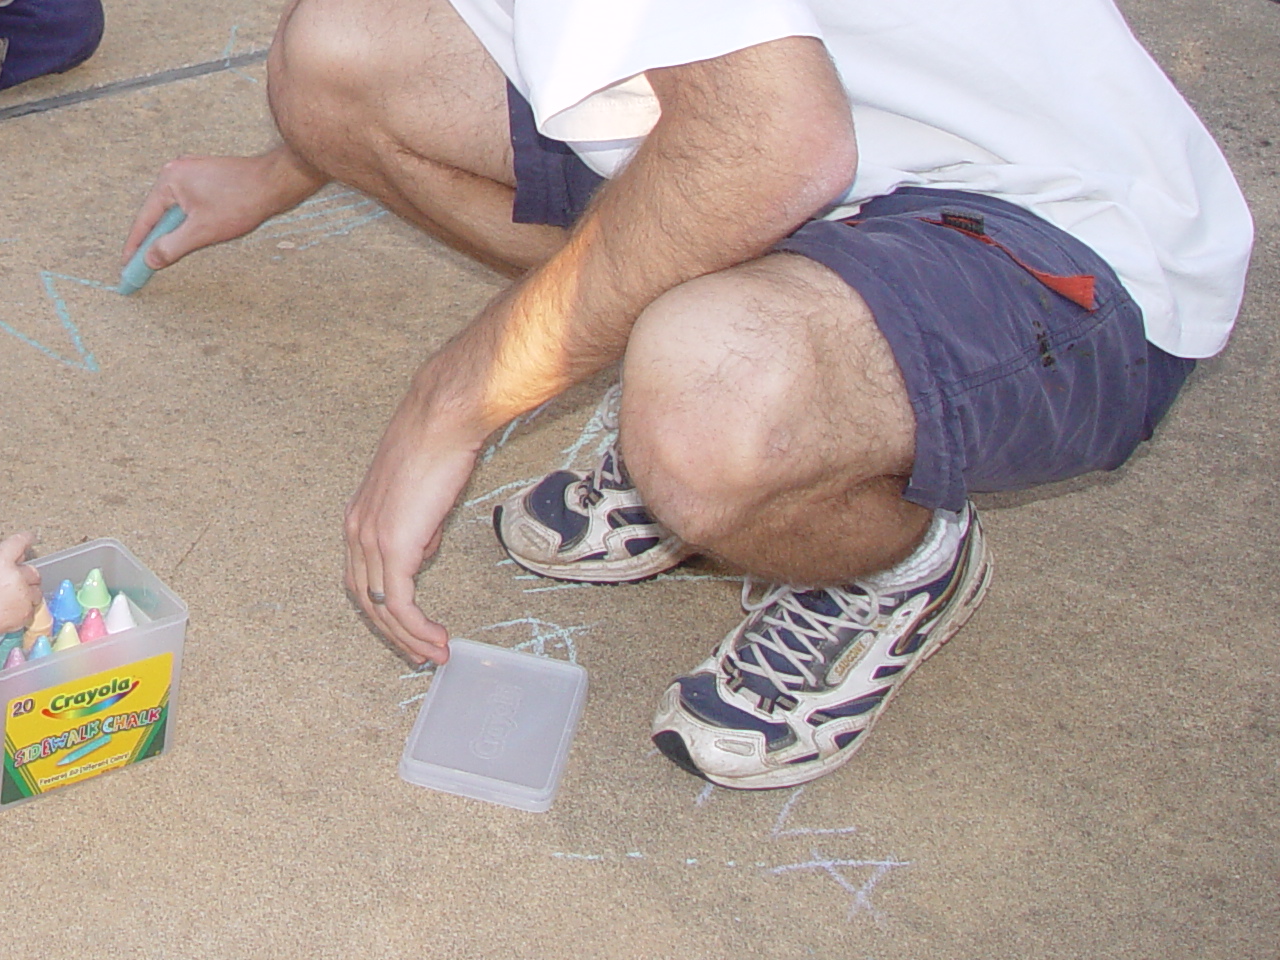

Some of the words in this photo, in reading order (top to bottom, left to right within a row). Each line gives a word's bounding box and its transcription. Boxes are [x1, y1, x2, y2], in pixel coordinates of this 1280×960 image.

[12, 698, 36, 718] 20
[50, 677, 131, 712] Crayola
[14, 719, 100, 768] SIDEWALK
[102, 707, 162, 734] CHALK
